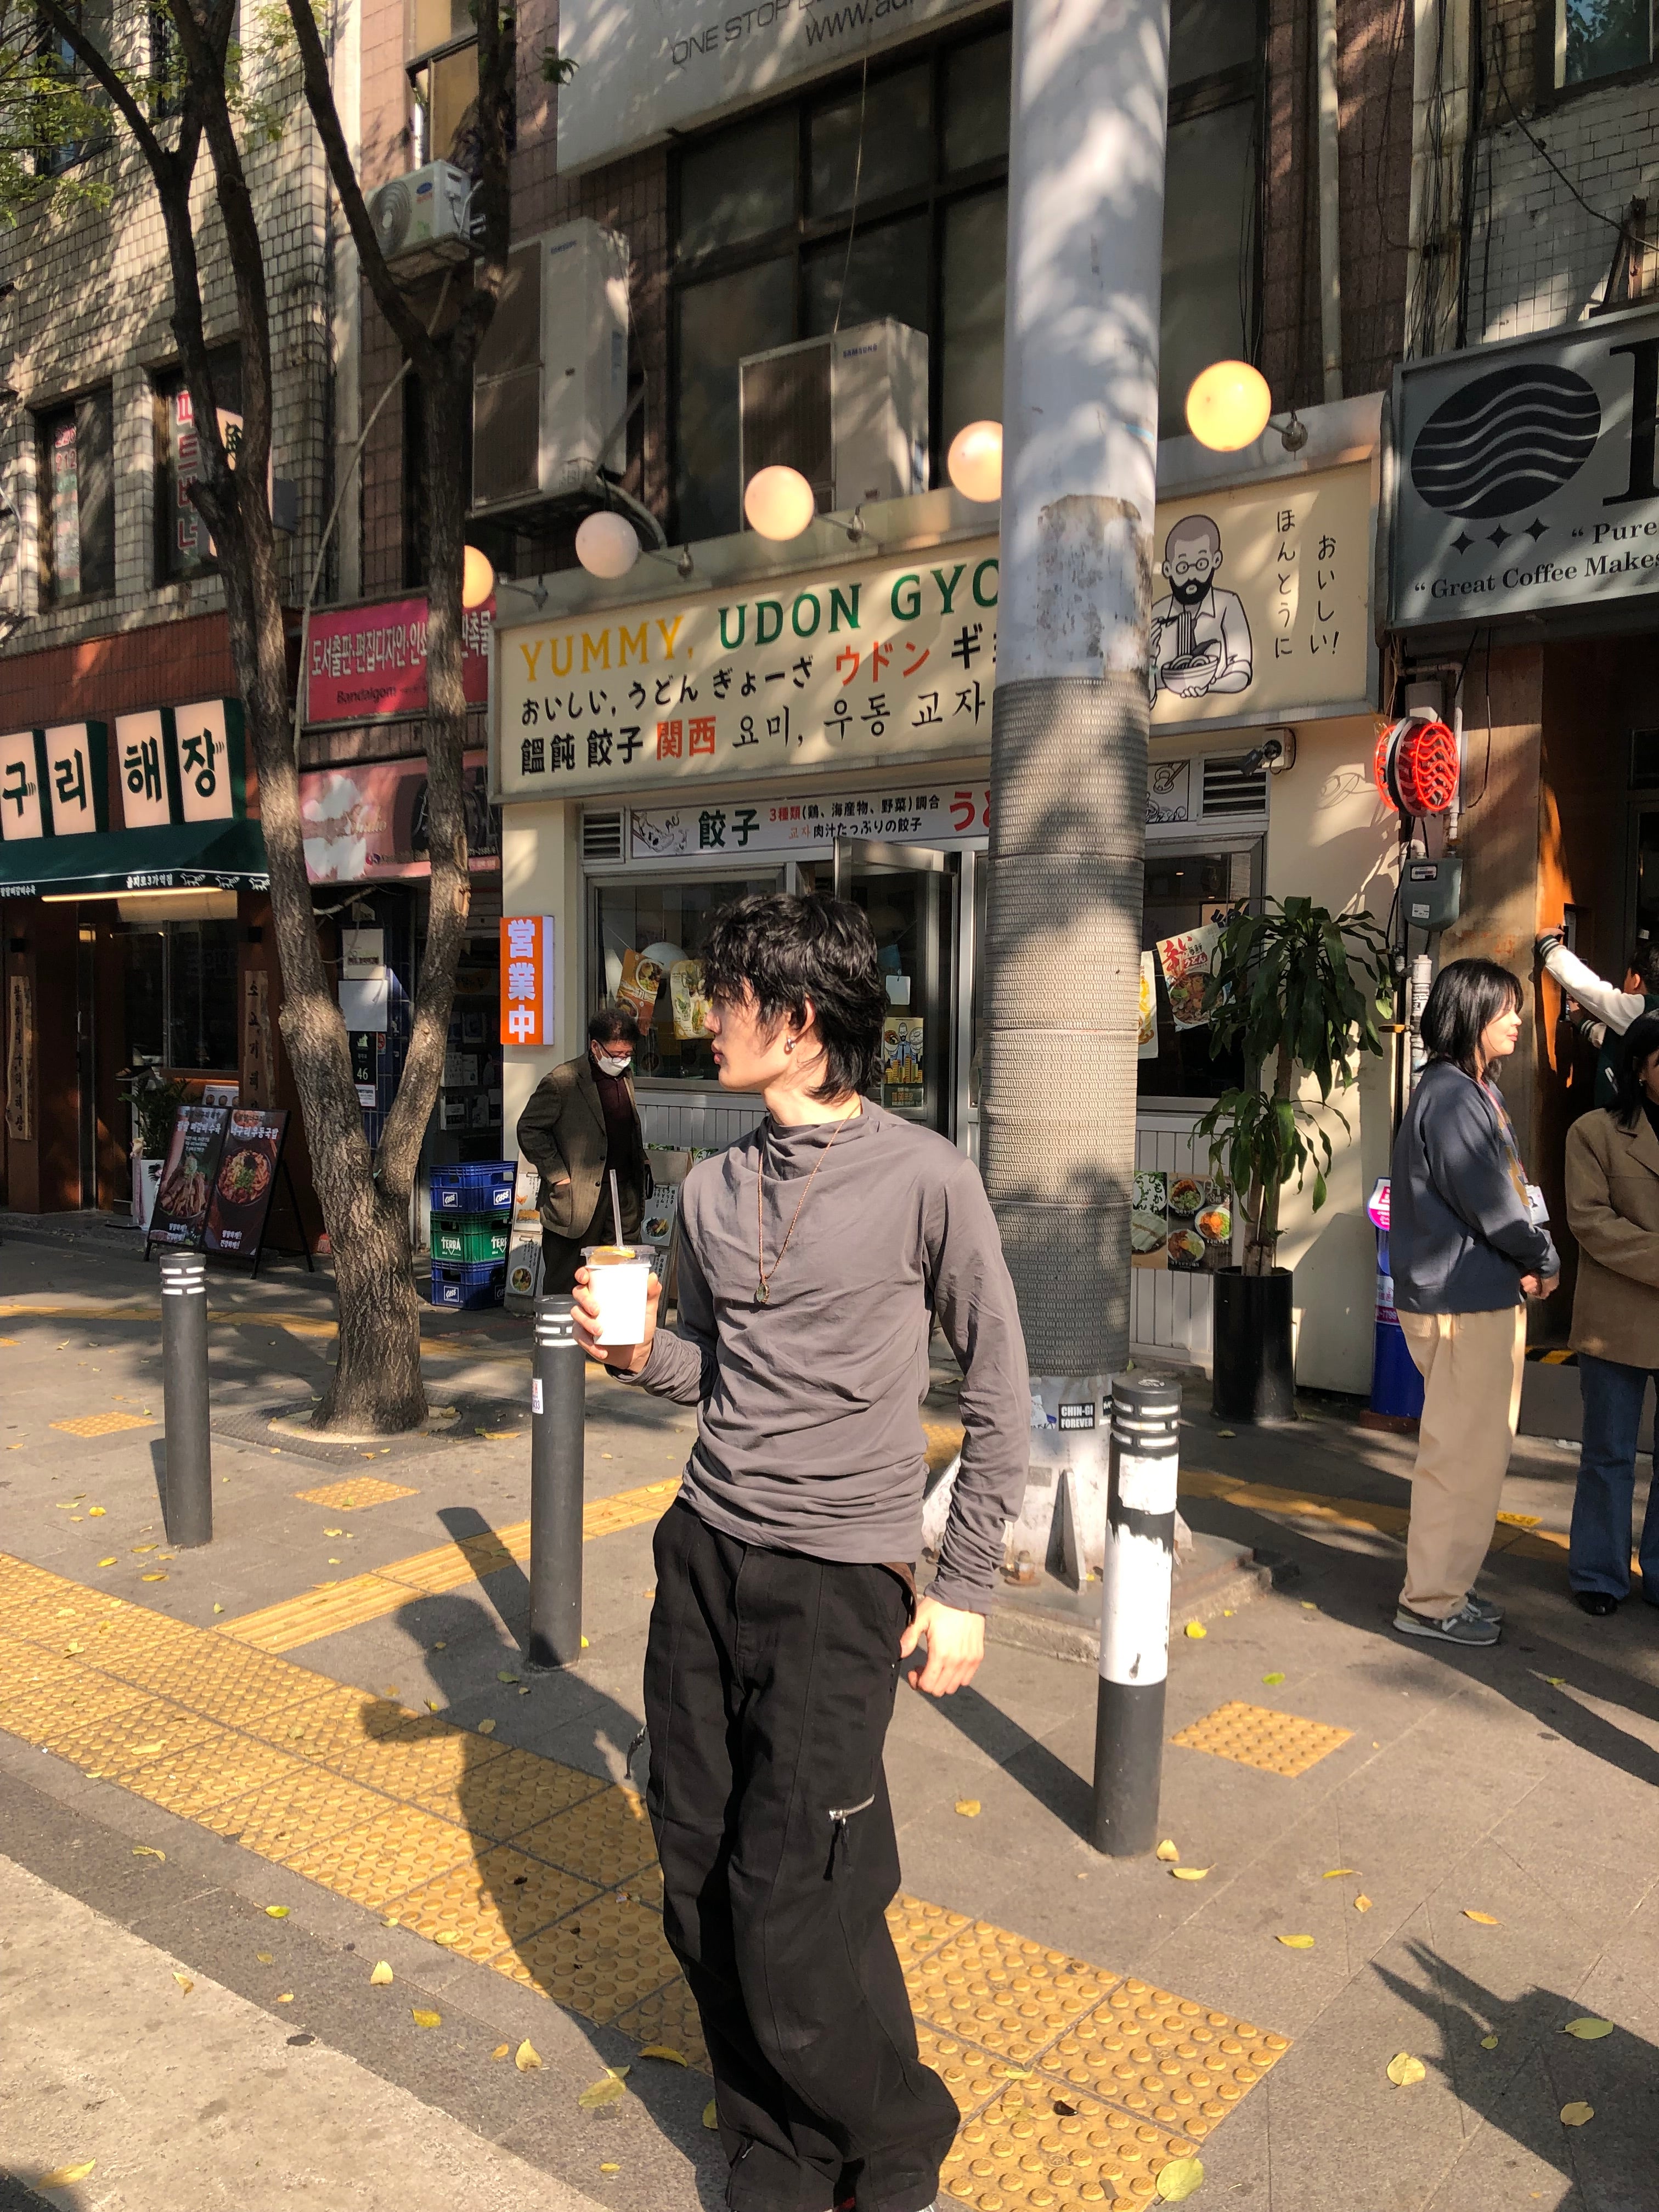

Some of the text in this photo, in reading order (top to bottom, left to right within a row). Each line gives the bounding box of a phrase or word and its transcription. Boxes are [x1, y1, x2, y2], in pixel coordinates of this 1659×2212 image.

[671, 25, 718, 65] ONE
[843, 343, 877, 358] SAMSUNG
[1276, 509, 1296, 658] ほんとうに
[1502, 562, 1578, 588] Coffee
[1584, 550, 1659, 578] Makes
[718, 583, 863, 651] UDON
[628, 673, 698, 704] うどん
[835, 640, 931, 686] ウドン
[951, 622, 997, 670] ギ
[823, 696, 891, 740] 우동
[911, 679, 987, 729] 교자
[586, 721, 644, 767] 餃子
[656, 715, 717, 761] 関西
[123, 727, 218, 803] 해장
[698, 809, 760, 850] 餃子
[507, 918, 536, 1043] 営業中
[1184, 956, 1206, 967] うどん
[357, 1067, 369, 1080] 46
[441, 1236, 461, 1251] TERRA
[1061, 1405, 1093, 1417] CHIN-GI
[1061, 1417, 1093, 1429] FOREVER
